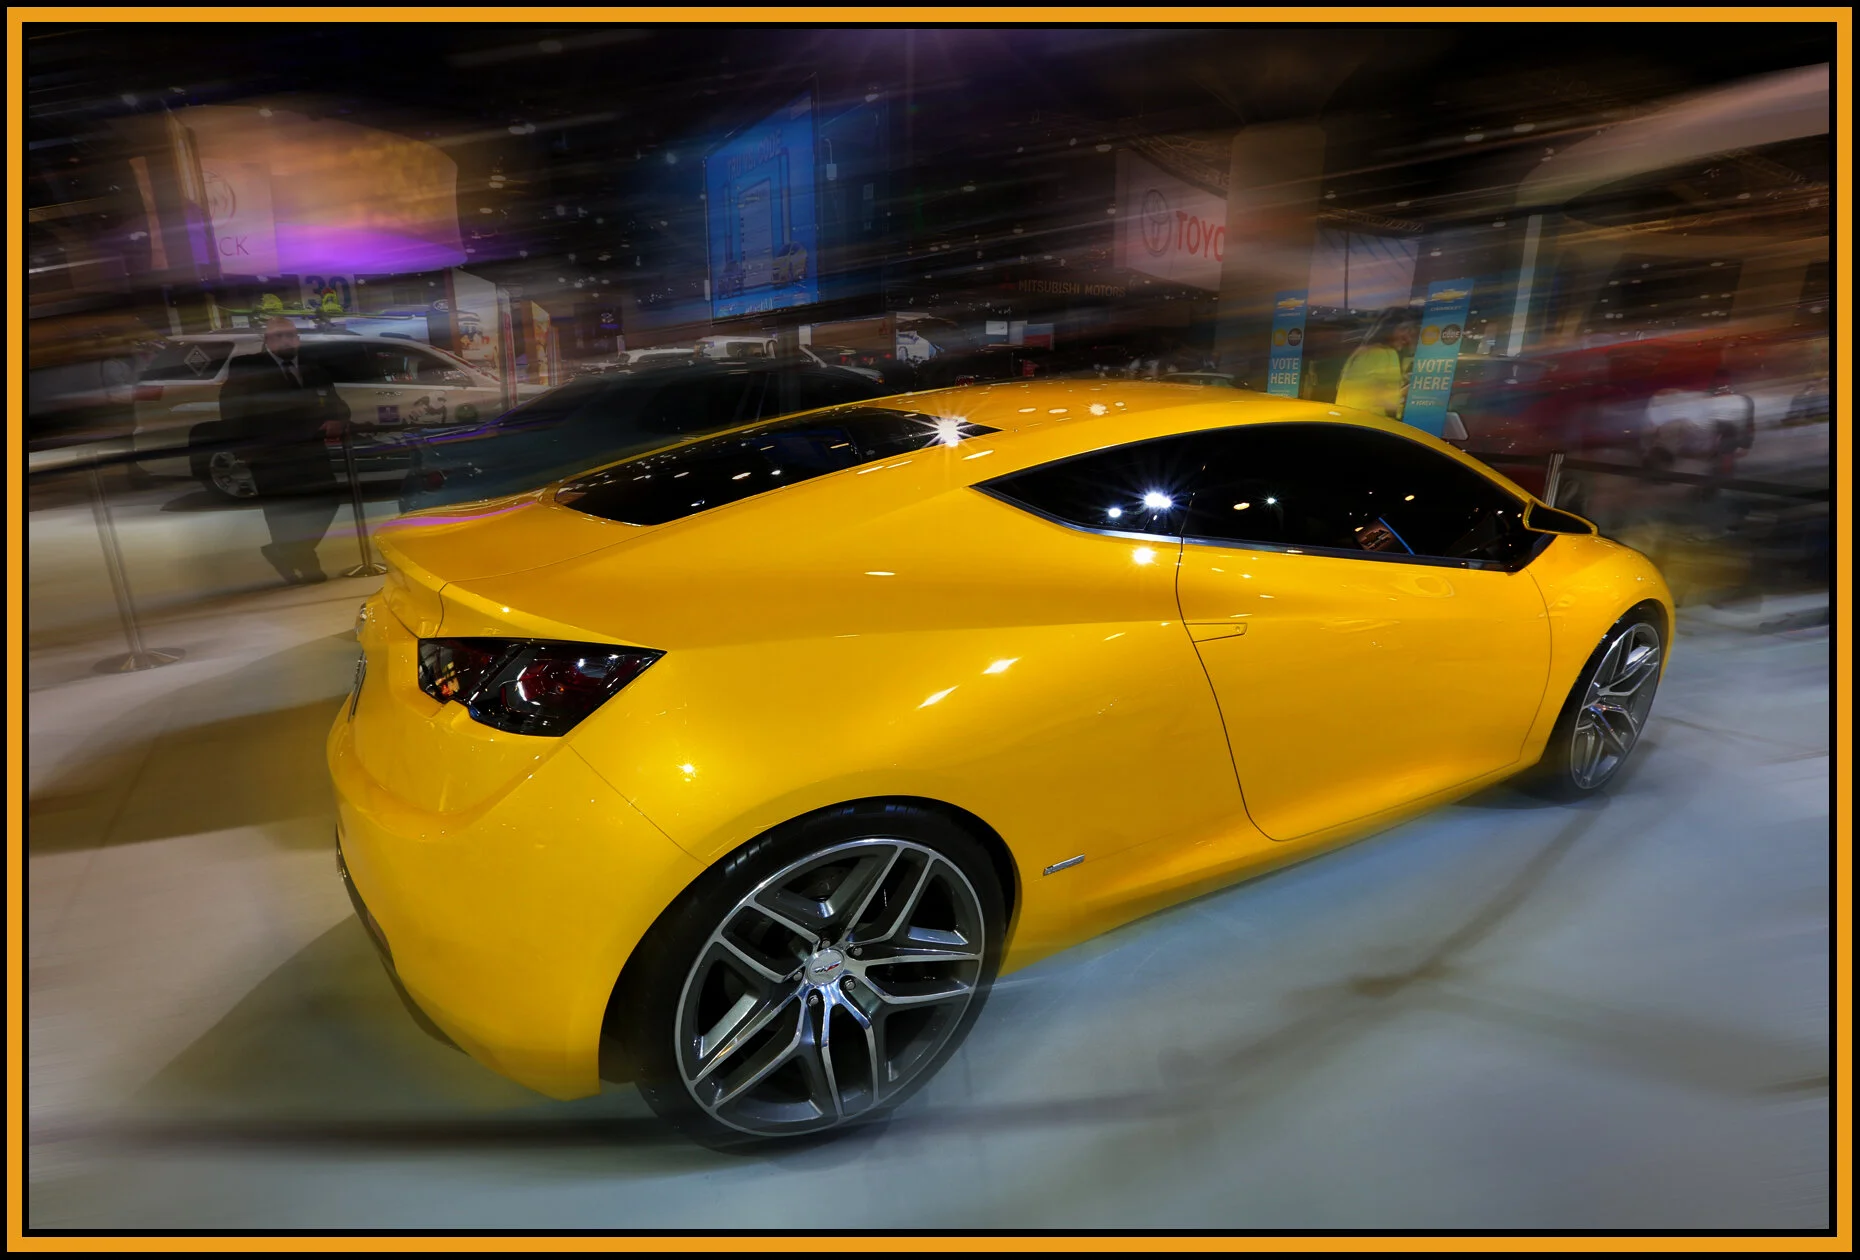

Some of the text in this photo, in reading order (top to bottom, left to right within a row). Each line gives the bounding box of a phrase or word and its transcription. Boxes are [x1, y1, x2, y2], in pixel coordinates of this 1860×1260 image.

[1018, 279, 1126, 297] MITSUBISHI MOTORS
[1272, 358, 1300, 370] VOTE
[1417, 358, 1455, 373] VOTE
[1270, 372, 1298, 385] HERE
[1412, 376, 1450, 391] HERE
